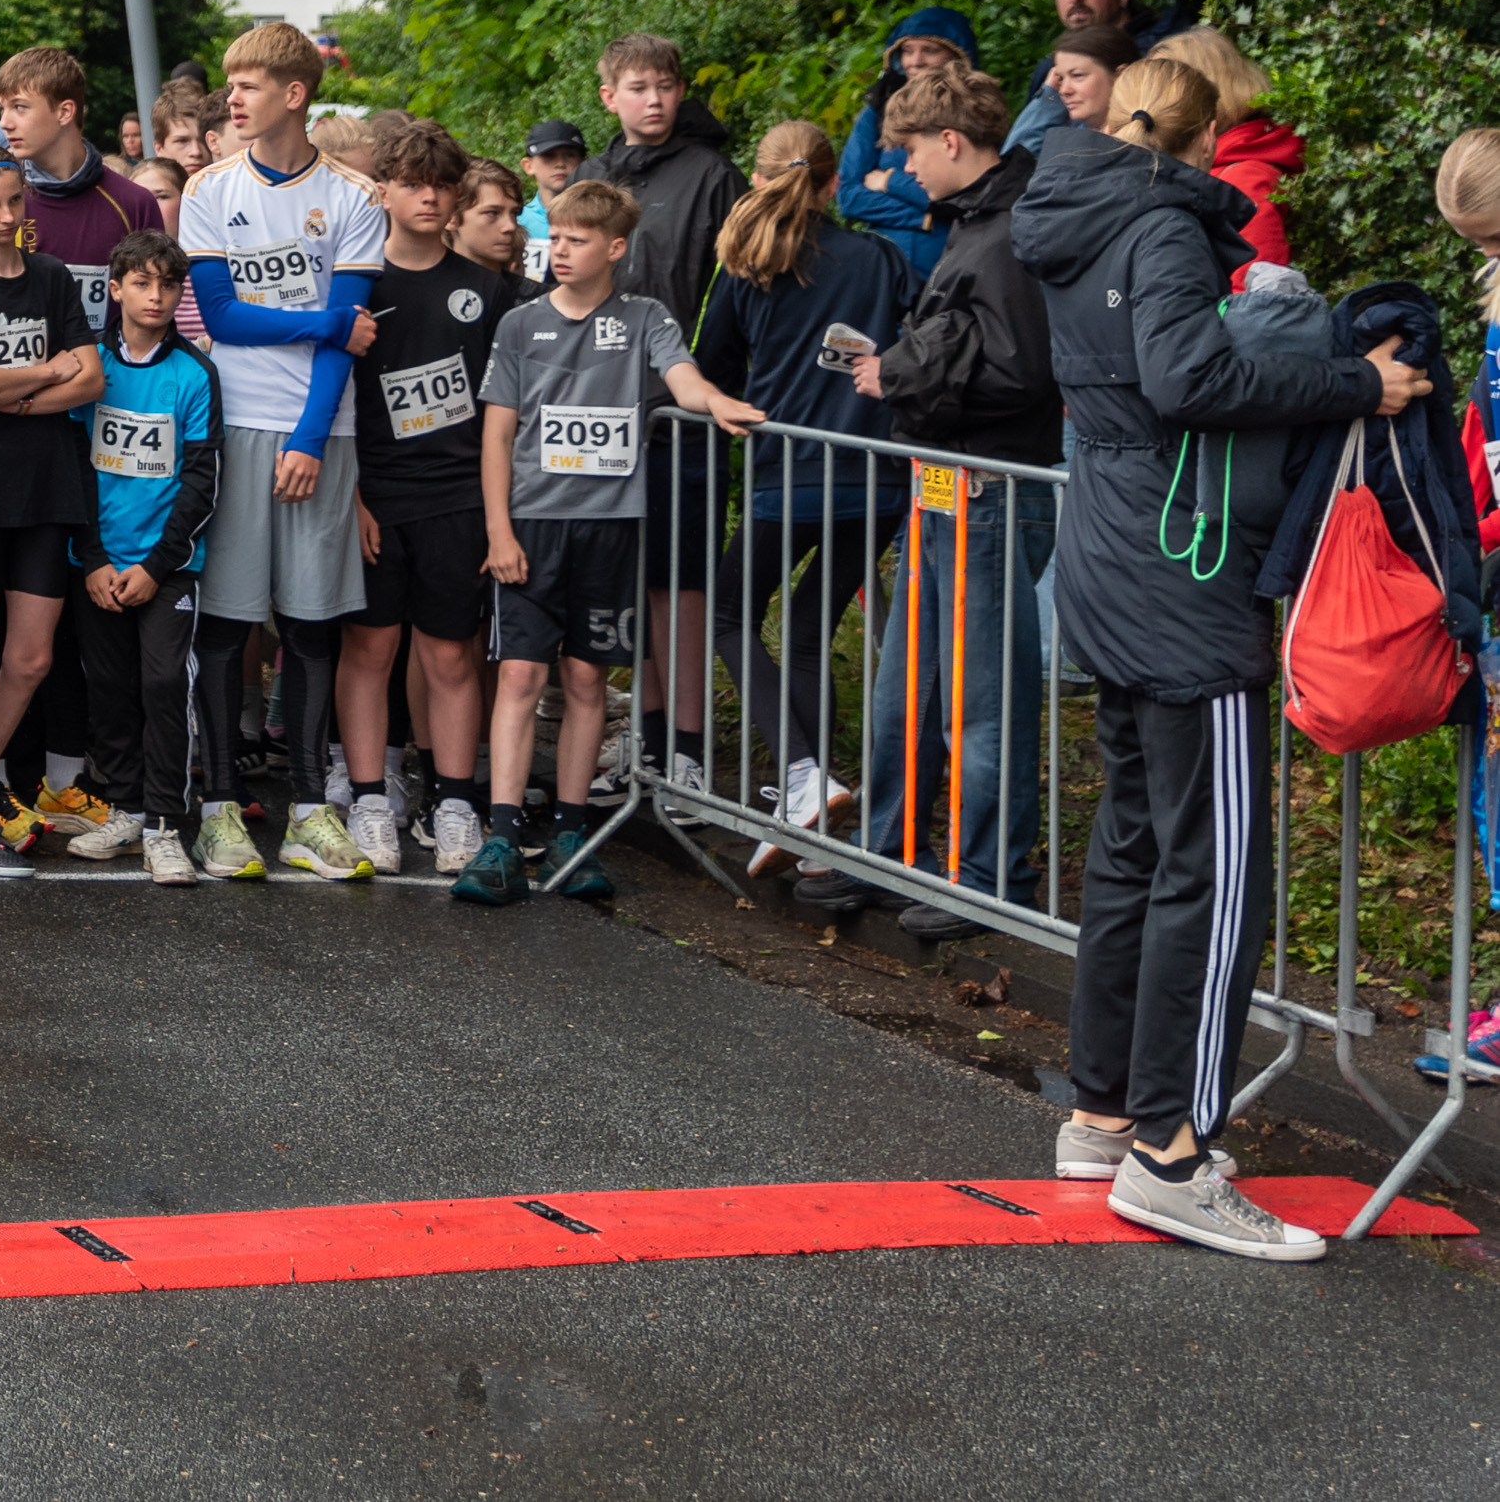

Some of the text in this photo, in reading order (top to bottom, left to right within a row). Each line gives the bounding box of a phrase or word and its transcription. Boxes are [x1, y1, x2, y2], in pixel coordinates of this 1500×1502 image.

[229, 251, 307, 285] 2099
[238, 286, 309, 304] EWE bruns
[387, 367, 467, 412] 2105
[401, 403, 468, 432] EWE bruns
[101, 420, 162, 451] 674
[543, 419, 630, 448] 2091
[95, 453, 166, 471] EWE bruns
[550, 455, 628, 468] EWE bruns
